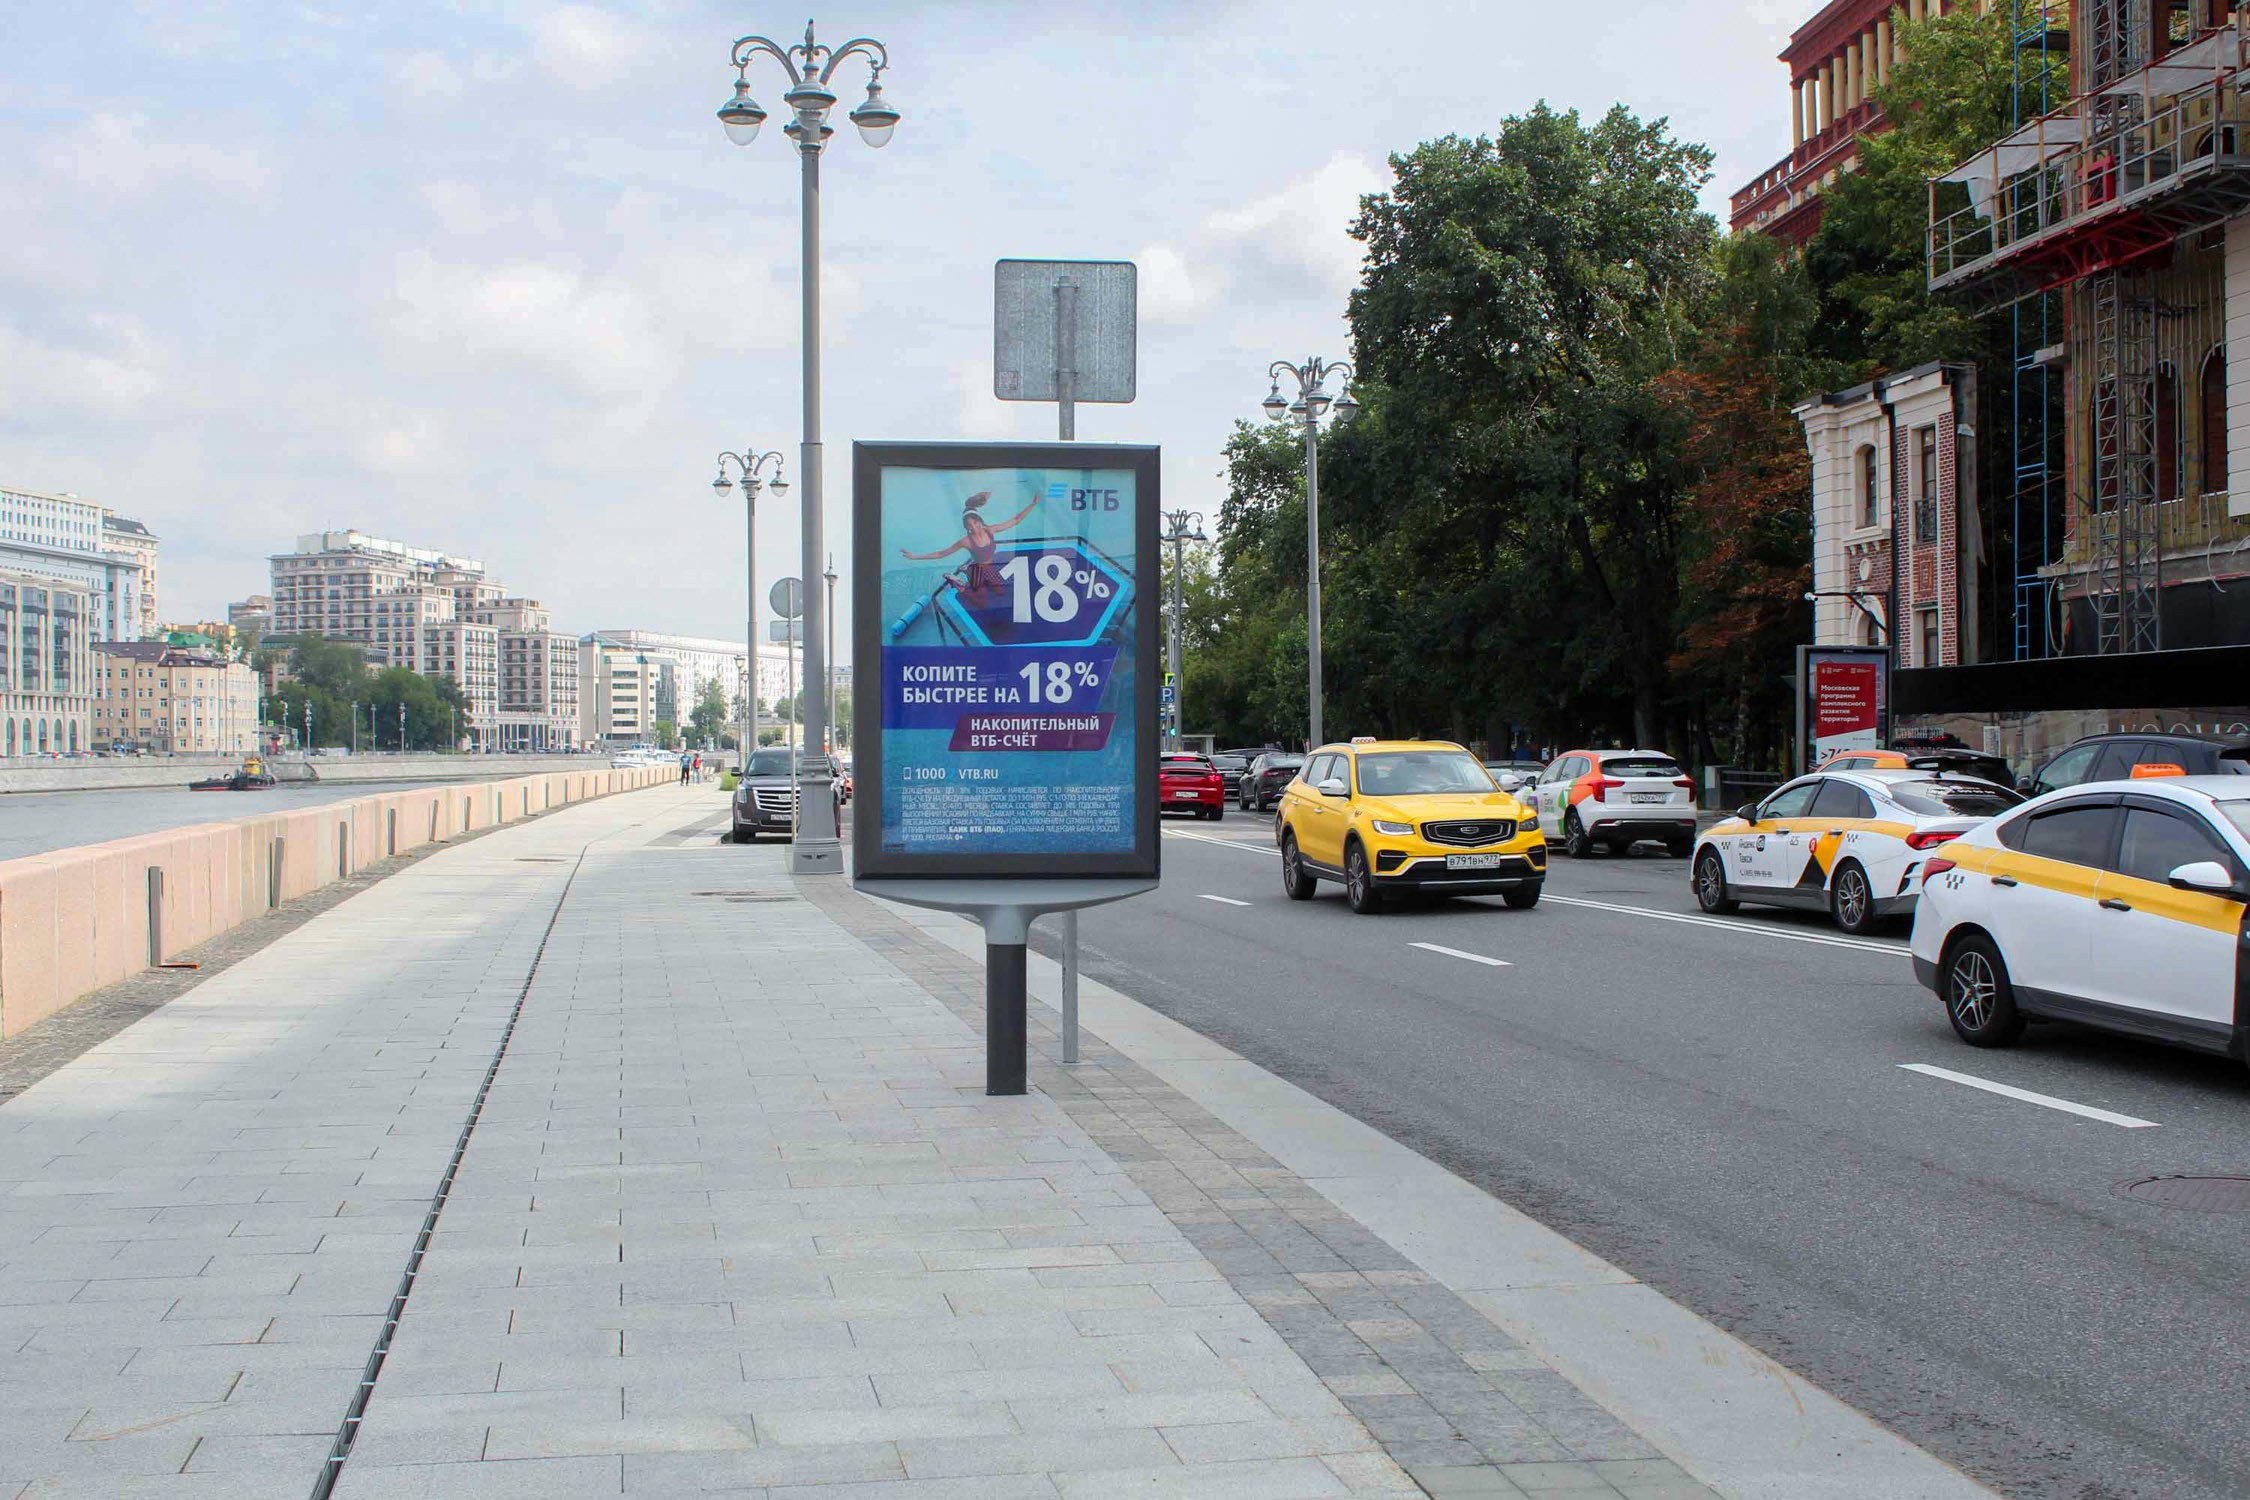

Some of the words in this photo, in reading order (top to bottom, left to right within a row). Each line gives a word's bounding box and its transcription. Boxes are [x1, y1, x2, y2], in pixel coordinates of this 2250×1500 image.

[1071, 489, 1120, 511] ВТБ
[998, 554, 1111, 624] 18%
[903, 666, 977, 682] КОПИТЕ
[903, 687, 988, 704] БЫСТРЕЕ
[994, 687, 1021, 703] НА
[1019, 661, 1099, 704] 18%
[1820, 684, 1861, 692] Московская
[971, 715, 1100, 731] НАКОПИТЕЛЬНЫЙ
[1820, 715, 1860, 724] территорий
[971, 732, 1038, 747] ВТБ-СЧЁТ
[915, 767, 946, 780] 1000
[958, 768, 999, 780] VTB.RU
